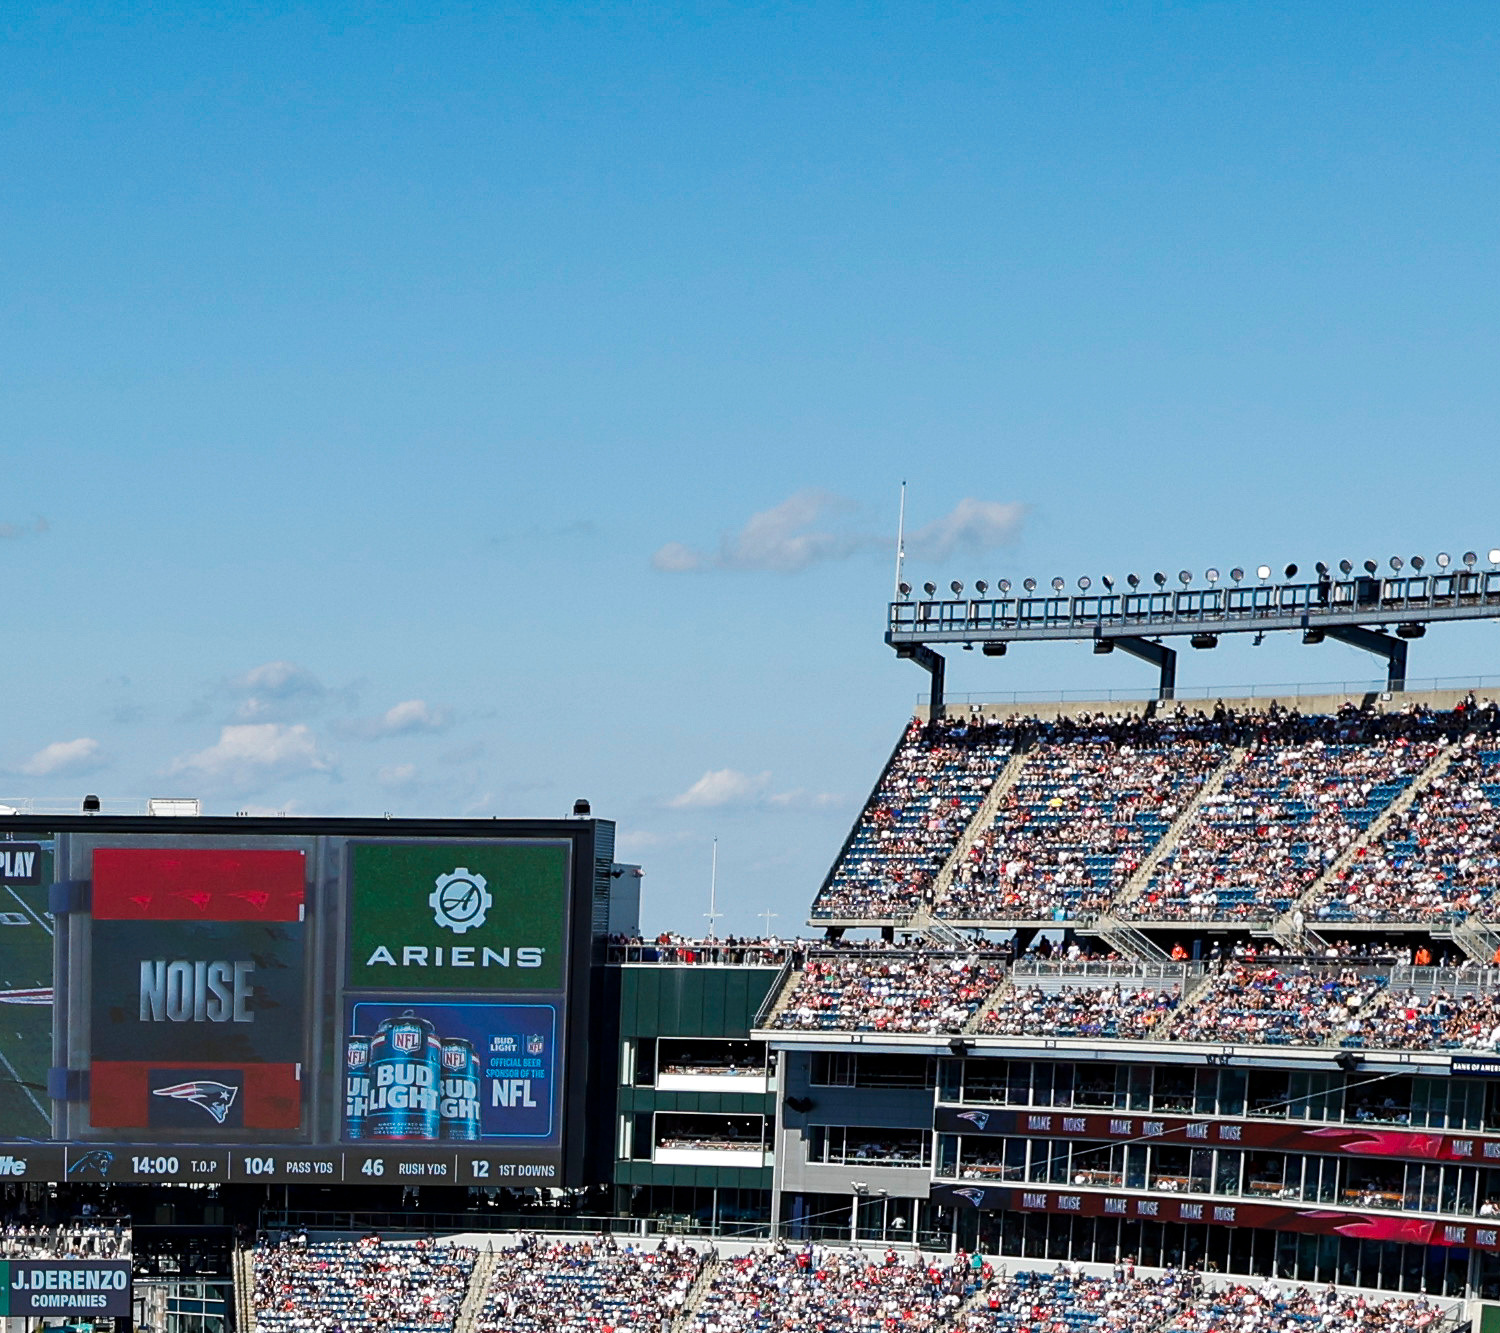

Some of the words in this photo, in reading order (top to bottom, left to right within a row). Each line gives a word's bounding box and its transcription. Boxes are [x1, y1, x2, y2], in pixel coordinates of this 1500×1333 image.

[367, 946, 541, 968] ARIENS
[139, 959, 256, 1022] NOISE
[396, 1034, 419, 1048] NFL
[490, 1043, 517, 1052] LIGHT
[490, 1058, 517, 1067] OFFICIAL
[520, 1058, 541, 1067] BEER
[377, 1064, 433, 1087] BUD
[370, 1086, 439, 1110] LIGHT
[492, 1079, 537, 1107] NFL
[131, 1156, 179, 1174] 14:00
[191, 1160, 217, 1174] T.O.P
[244, 1157, 275, 1175] 104
[286, 1160, 311, 1174] PASS
[314, 1161, 333, 1175] YDS
[361, 1158, 384, 1176] 46
[399, 1163, 424, 1175] RUSH
[427, 1163, 447, 1175] YDS
[471, 1160, 489, 1178] 12
[499, 1165, 516, 1177] 1ST
[518, 1165, 555, 1177] DOWNS
[31, 1293, 108, 1308] COMPANIES
